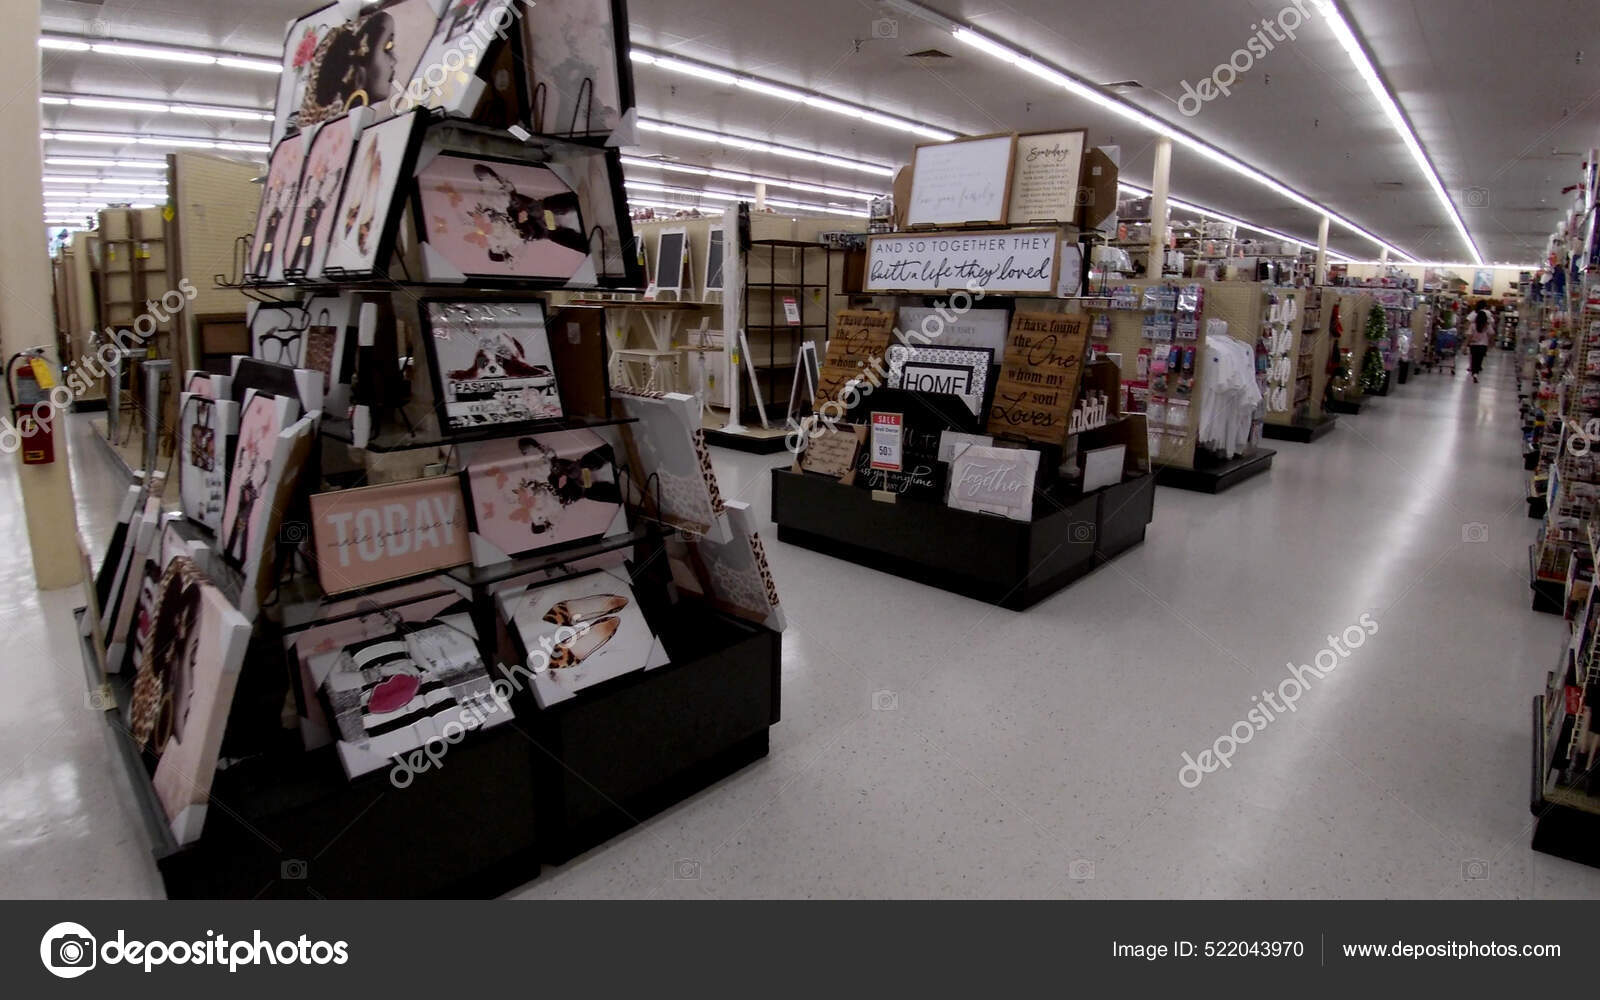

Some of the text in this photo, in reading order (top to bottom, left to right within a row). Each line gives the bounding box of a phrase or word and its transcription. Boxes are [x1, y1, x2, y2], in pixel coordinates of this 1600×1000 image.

[876, 242, 903, 253] AND
[908, 241, 926, 252] SO
[932, 238, 1007, 252] TOGETHER
[1013, 237, 1050, 250] THEY
[871, 260, 921, 282] built
[921, 258, 951, 288] life
[997, 256, 1051, 281] loved
[1016, 318, 1081, 335] I have found
[1013, 335, 1080, 367] the One
[906, 373, 966, 395] HOME
[1008, 368, 1064, 386] whom my
[456, 382, 504, 393] FASHION
[992, 391, 1060, 427] Loves
[1031, 392, 1059, 406] soul
[878, 415, 895, 424] SALE
[960, 464, 1027, 496] Together
[328, 495, 457, 567] TODAY
